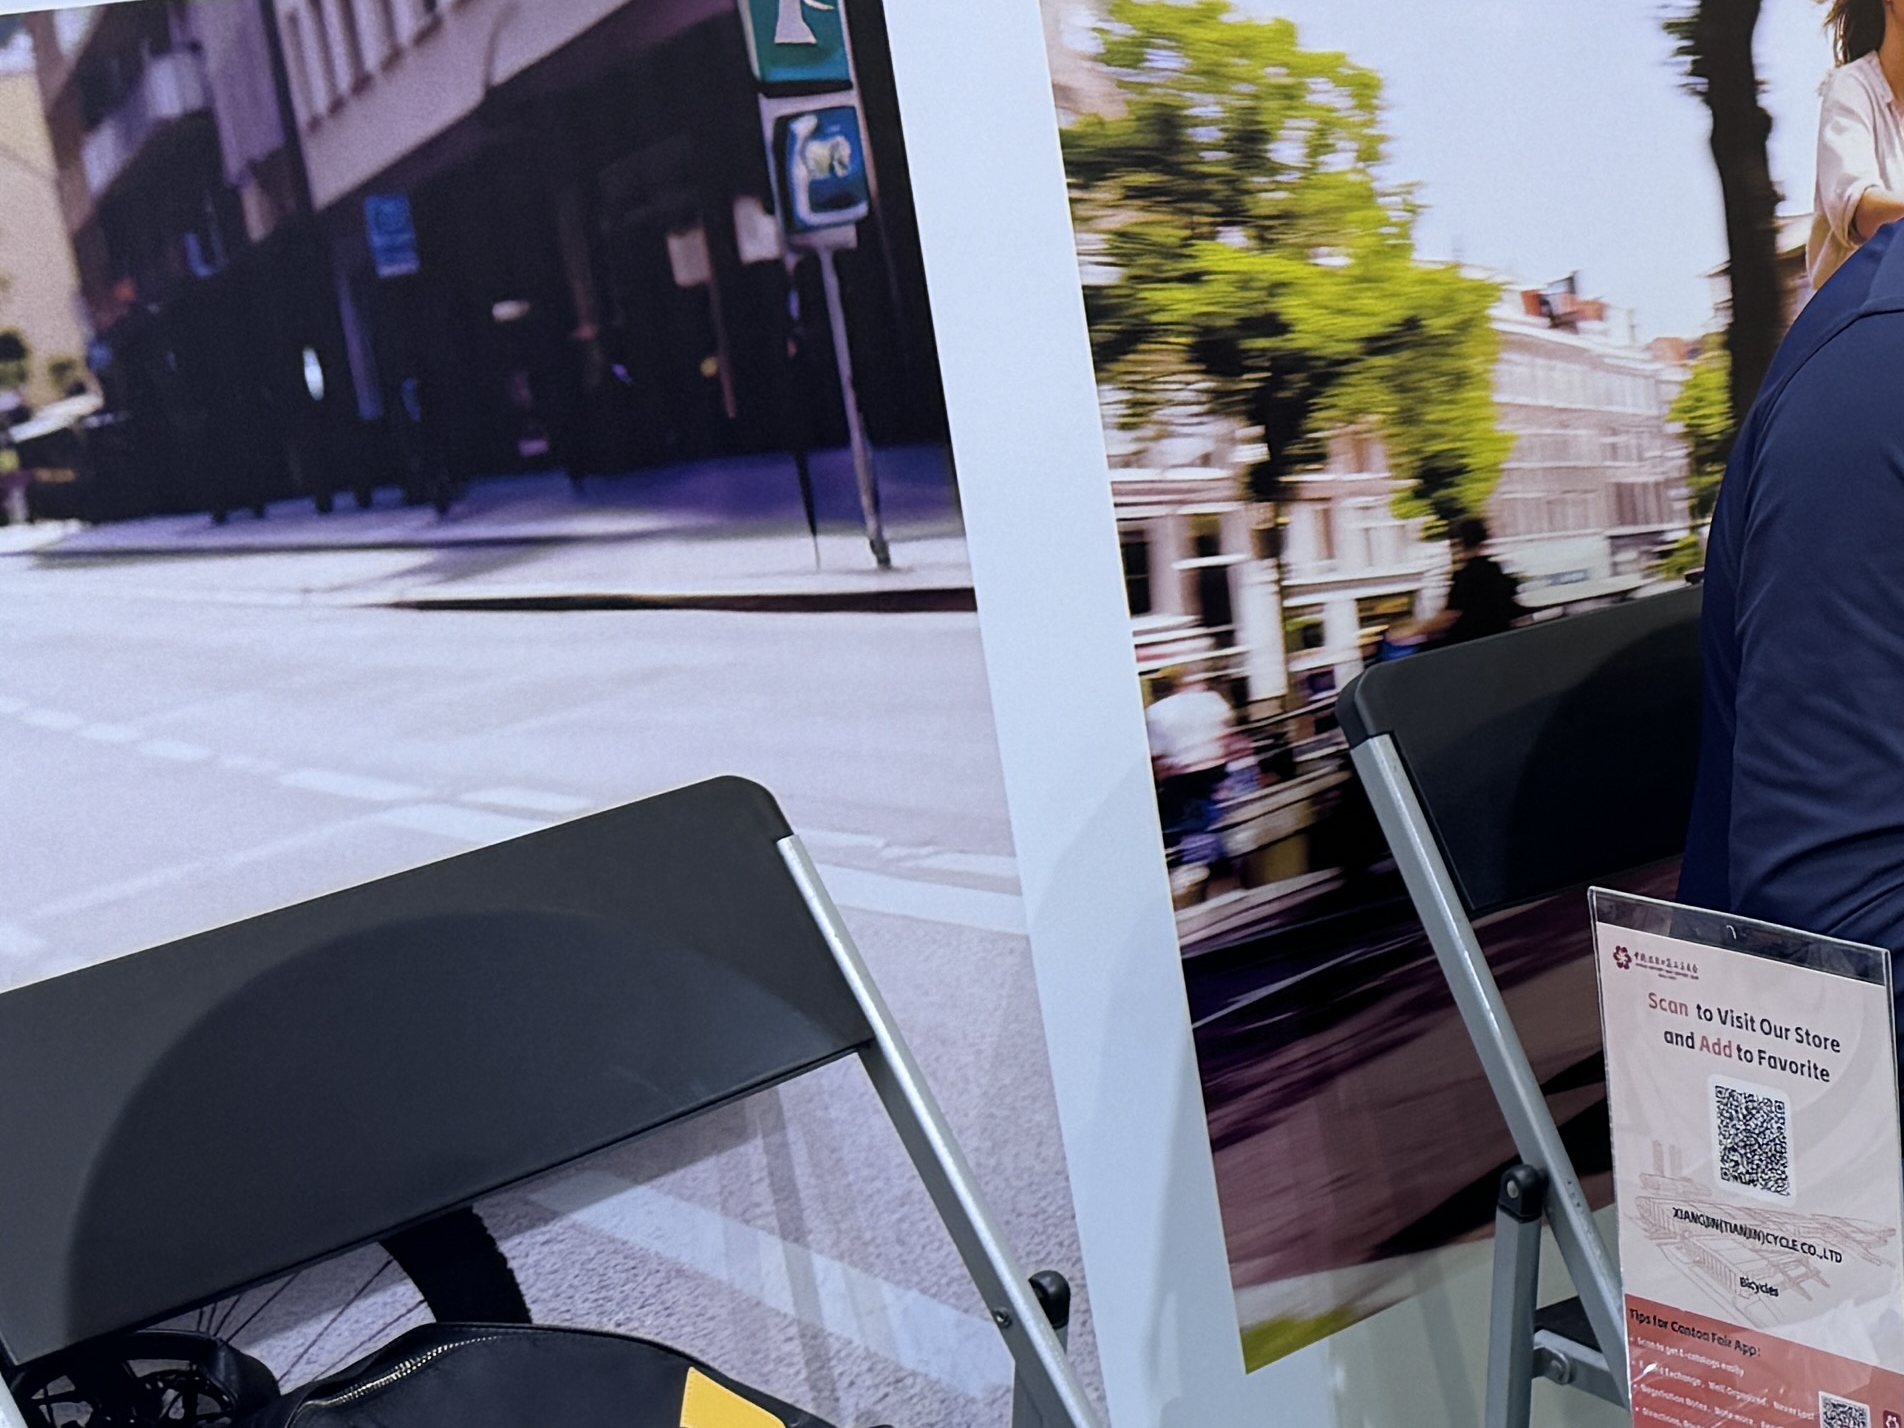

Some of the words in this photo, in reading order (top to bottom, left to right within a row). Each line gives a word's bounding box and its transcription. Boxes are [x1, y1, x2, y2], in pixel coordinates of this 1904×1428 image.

[1648, 992, 1688, 1017] Scan
[1696, 1004, 1714, 1022] to
[1717, 1008, 1756, 1033] Visit
[1760, 1018, 1791, 1041] Our
[1795, 1026, 1841, 1053] Store
[1664, 1029, 1695, 1050] and
[1700, 1035, 1732, 1058] Add
[1736, 1044, 1753, 1064] to
[1758, 1049, 1830, 1082] Favorite
[1740, 1277, 1779, 1297] Bicycles
[1629, 1309, 1651, 1326] Tips
[1653, 1318, 1669, 1330] for
[1671, 1321, 1710, 1342] Canton
[1711, 1331, 1732, 1349] Fair
